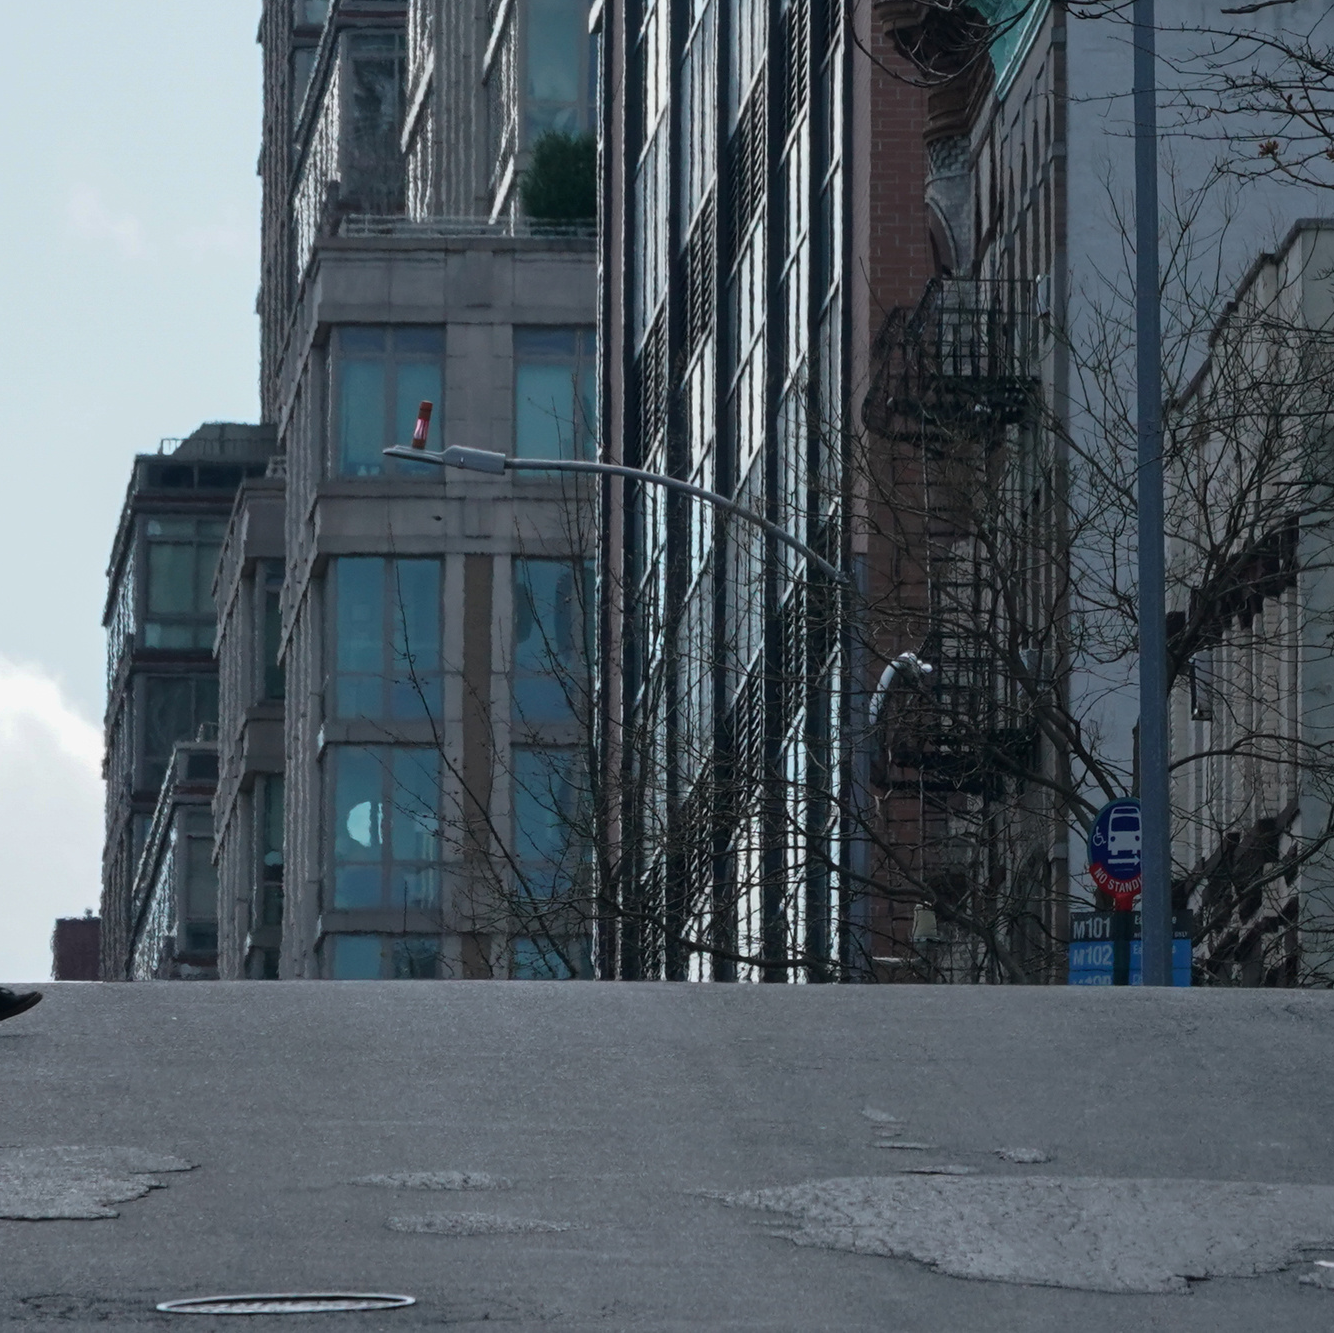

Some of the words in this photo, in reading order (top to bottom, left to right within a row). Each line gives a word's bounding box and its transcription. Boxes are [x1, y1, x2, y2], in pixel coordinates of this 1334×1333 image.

[1094, 867, 1108, 884] NO
[1073, 917, 1111, 940] M101
[1073, 944, 1114, 966] M102
